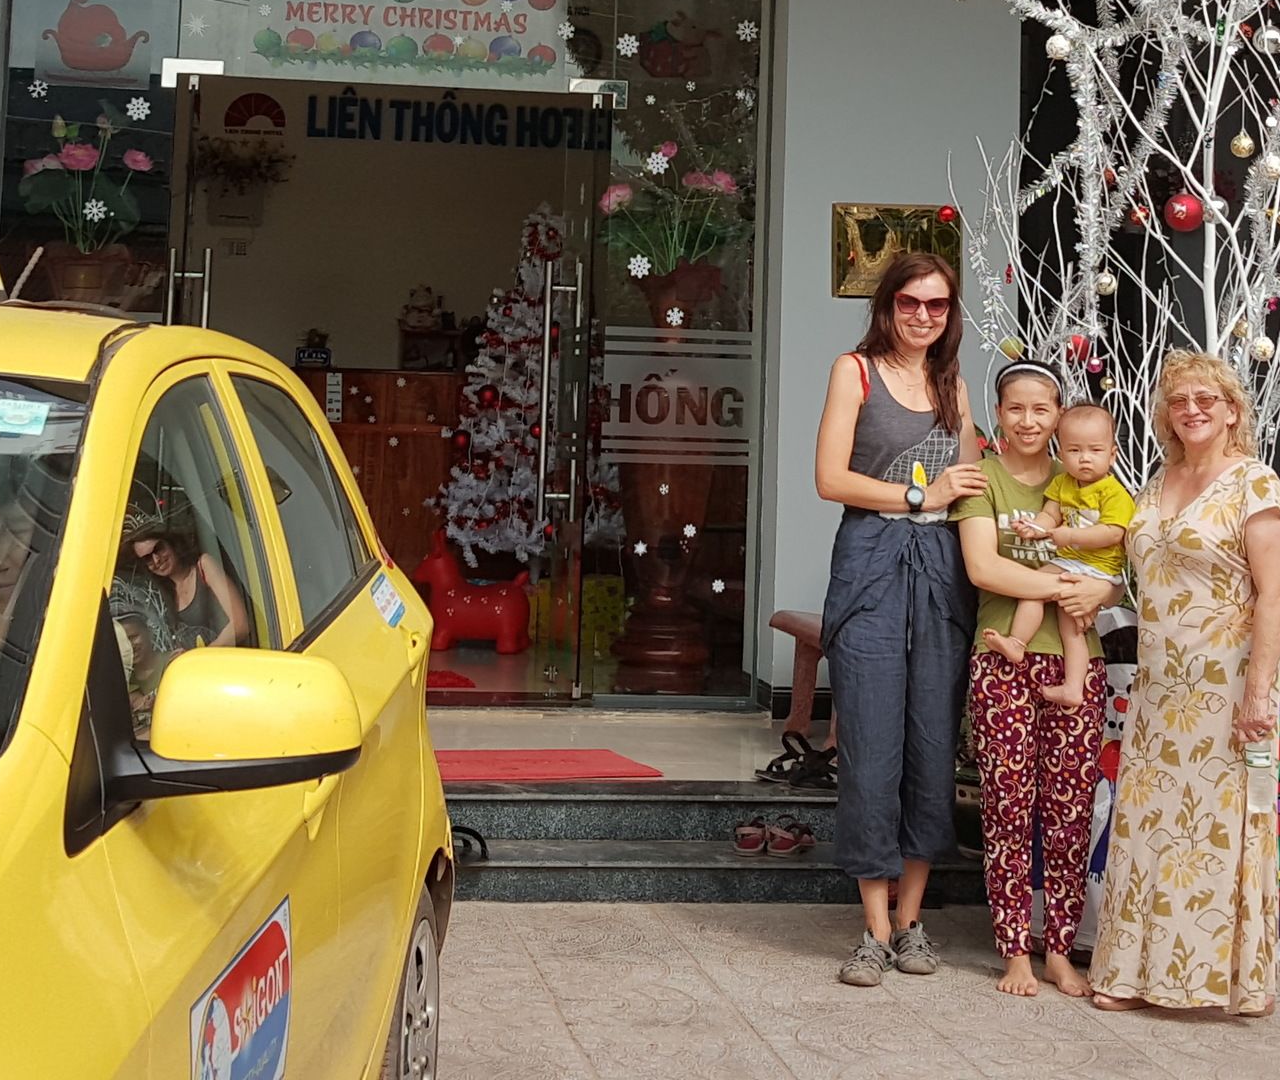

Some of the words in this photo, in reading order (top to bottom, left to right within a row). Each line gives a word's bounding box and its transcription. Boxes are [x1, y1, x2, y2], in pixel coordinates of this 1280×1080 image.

[285, 0, 375, 26] MERRY
[382, 6, 528, 34] CHRISTMAS
[306, 86, 383, 141] LIÊN
